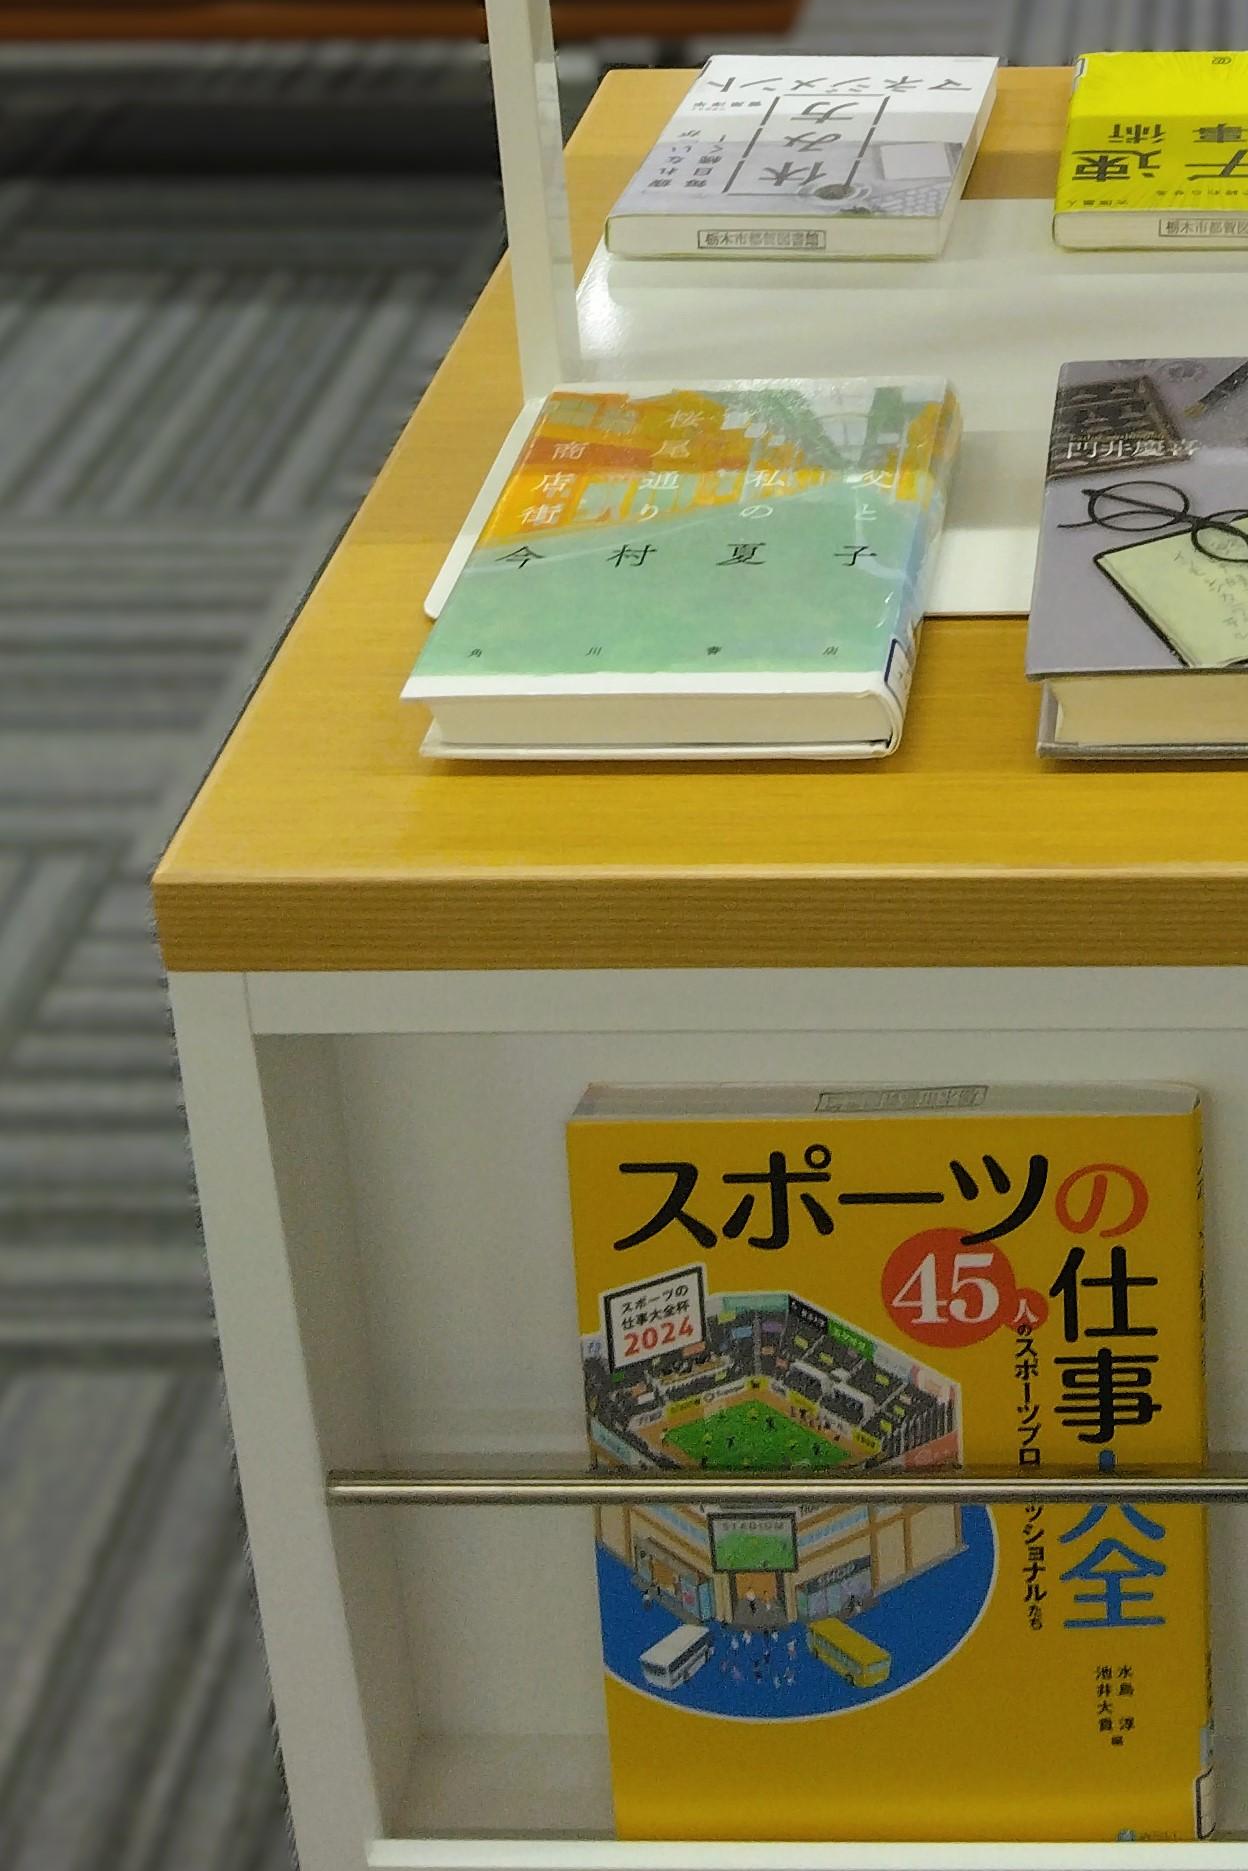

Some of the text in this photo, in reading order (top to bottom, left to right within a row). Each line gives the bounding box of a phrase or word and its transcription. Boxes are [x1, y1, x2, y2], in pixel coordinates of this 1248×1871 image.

[707, 76, 973, 93] マネジメント
[759, 100, 860, 187] 休み方
[519, 442, 589, 525] 商店街
[739, 470, 786, 519] 私の
[853, 470, 897, 521] 父と
[495, 543, 877, 569] 今村夏子
[613, 1144, 1150, 1250] スポーツの
[622, 1284, 689, 1315] スポーツの
[890, 1250, 1001, 1325] 45
[622, 1300, 691, 1328] 仕事大全杯
[624, 1316, 694, 1357] 2024
